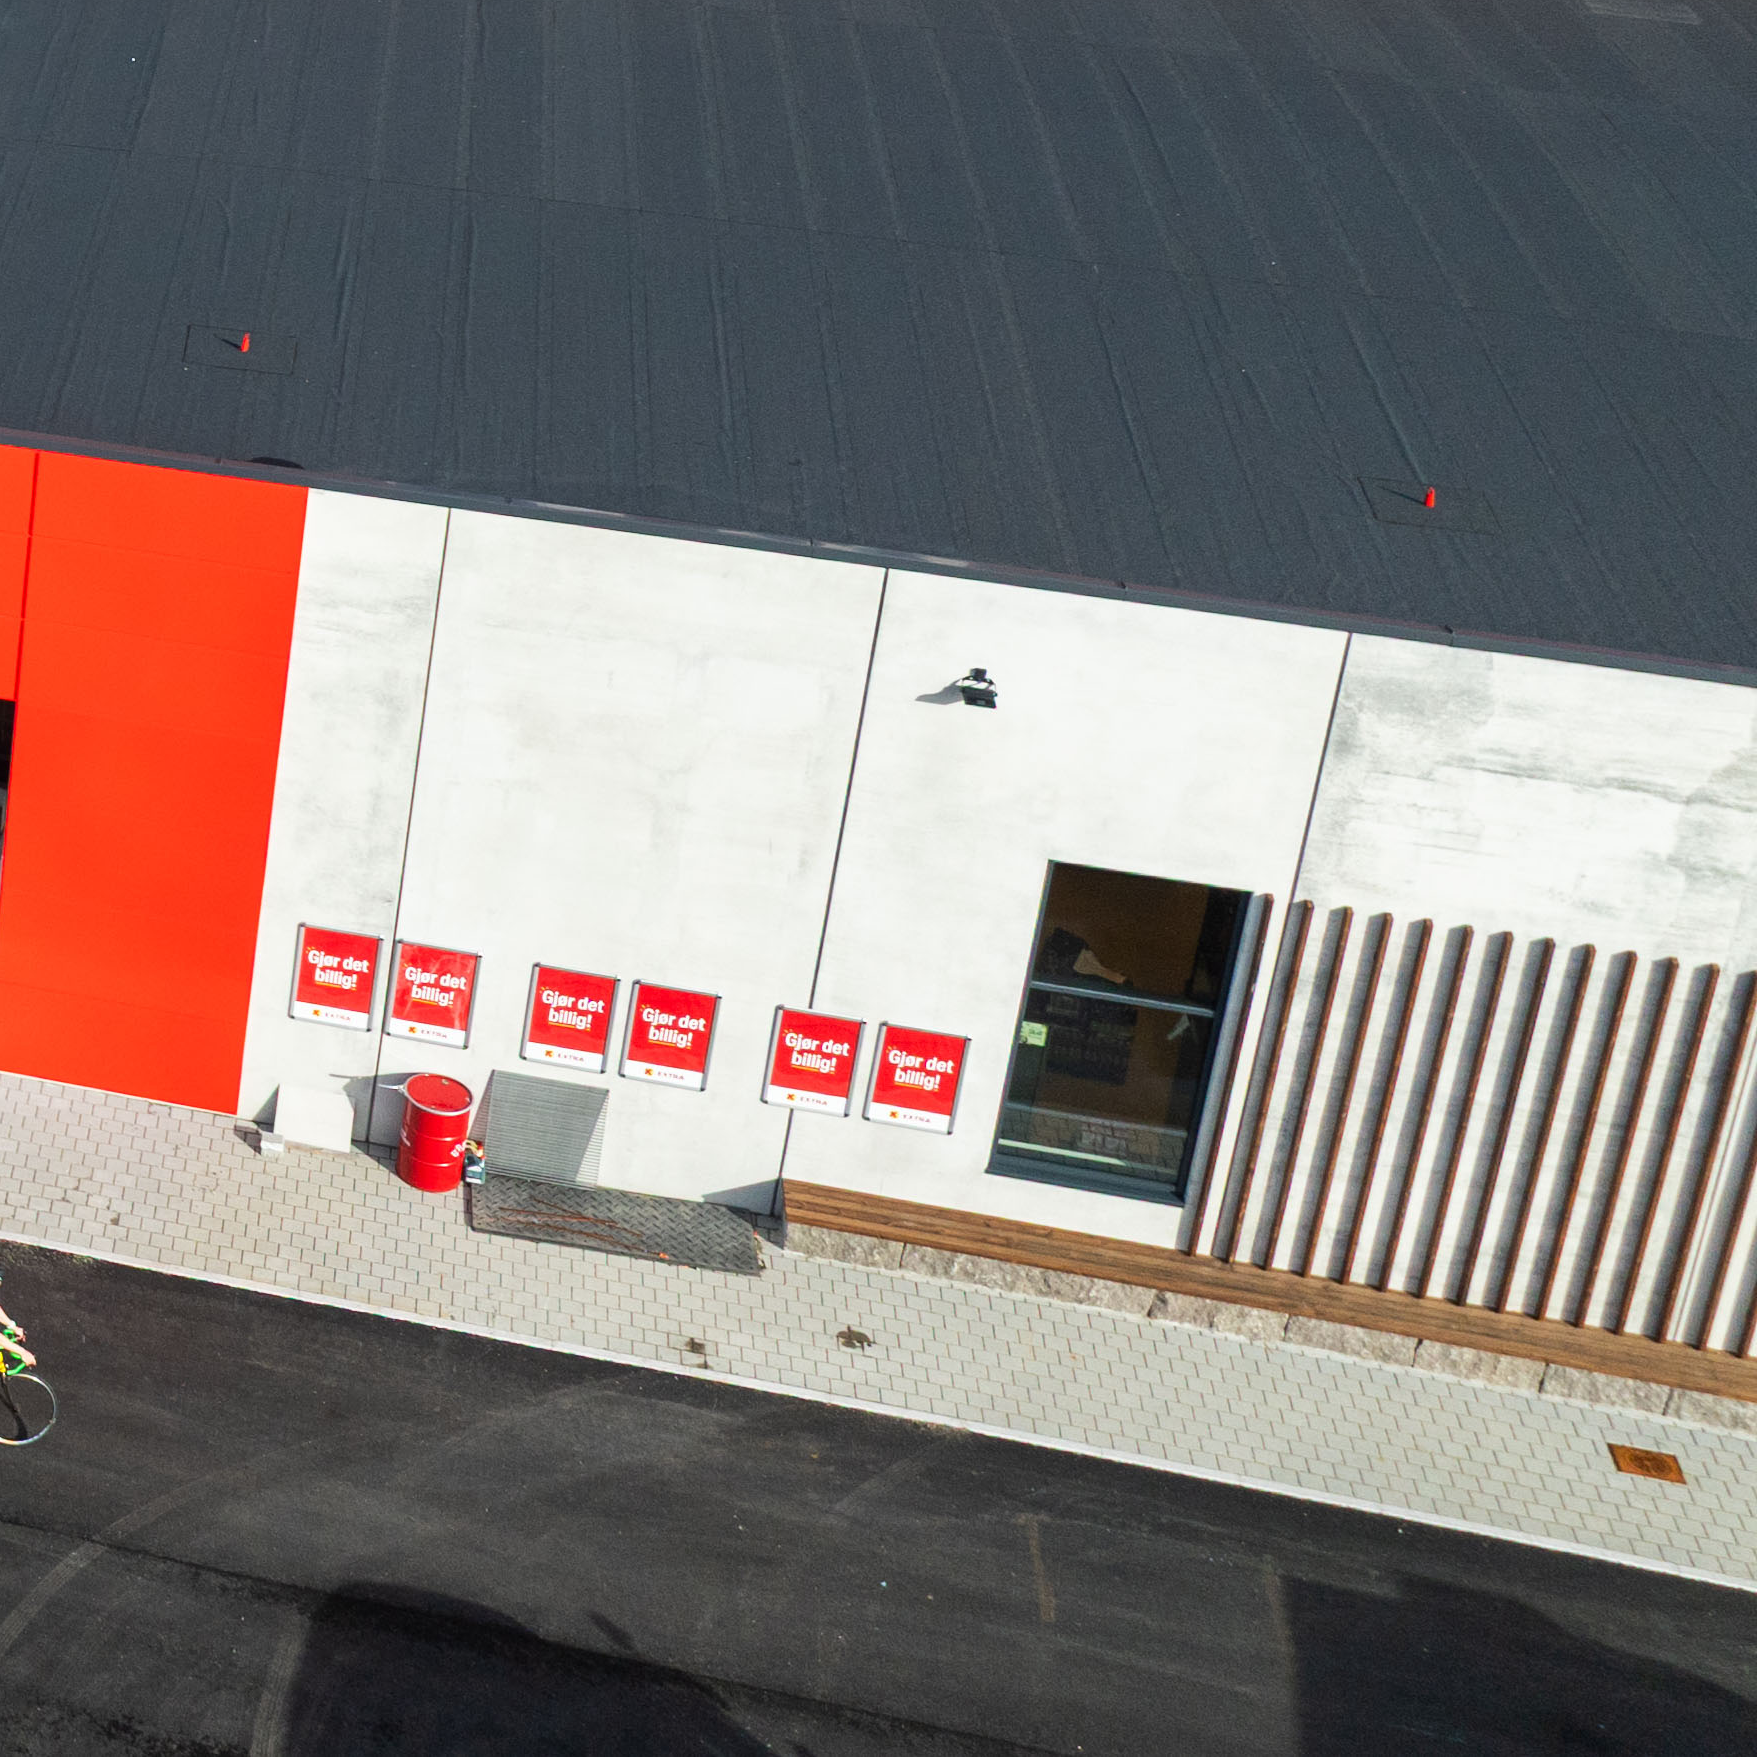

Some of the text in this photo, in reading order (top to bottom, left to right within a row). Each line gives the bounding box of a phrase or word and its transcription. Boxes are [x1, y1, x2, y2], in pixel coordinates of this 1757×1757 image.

[307, 949, 369, 974] Gjør det
[315, 968, 358, 990] billig!
[405, 966, 466, 991] Gjør det
[411, 985, 455, 1007] billig!
[541, 989, 604, 1014] Gjør det
[548, 1007, 592, 1030] billig!
[642, 1007, 706, 1032] Gjør det
[648, 1026, 693, 1049] billig!
[785, 1032, 849, 1057] Gjør det
[791, 1051, 836, 1074] billig!
[888, 1049, 954, 1075] Gjør det
[894, 1068, 940, 1091] billig!
